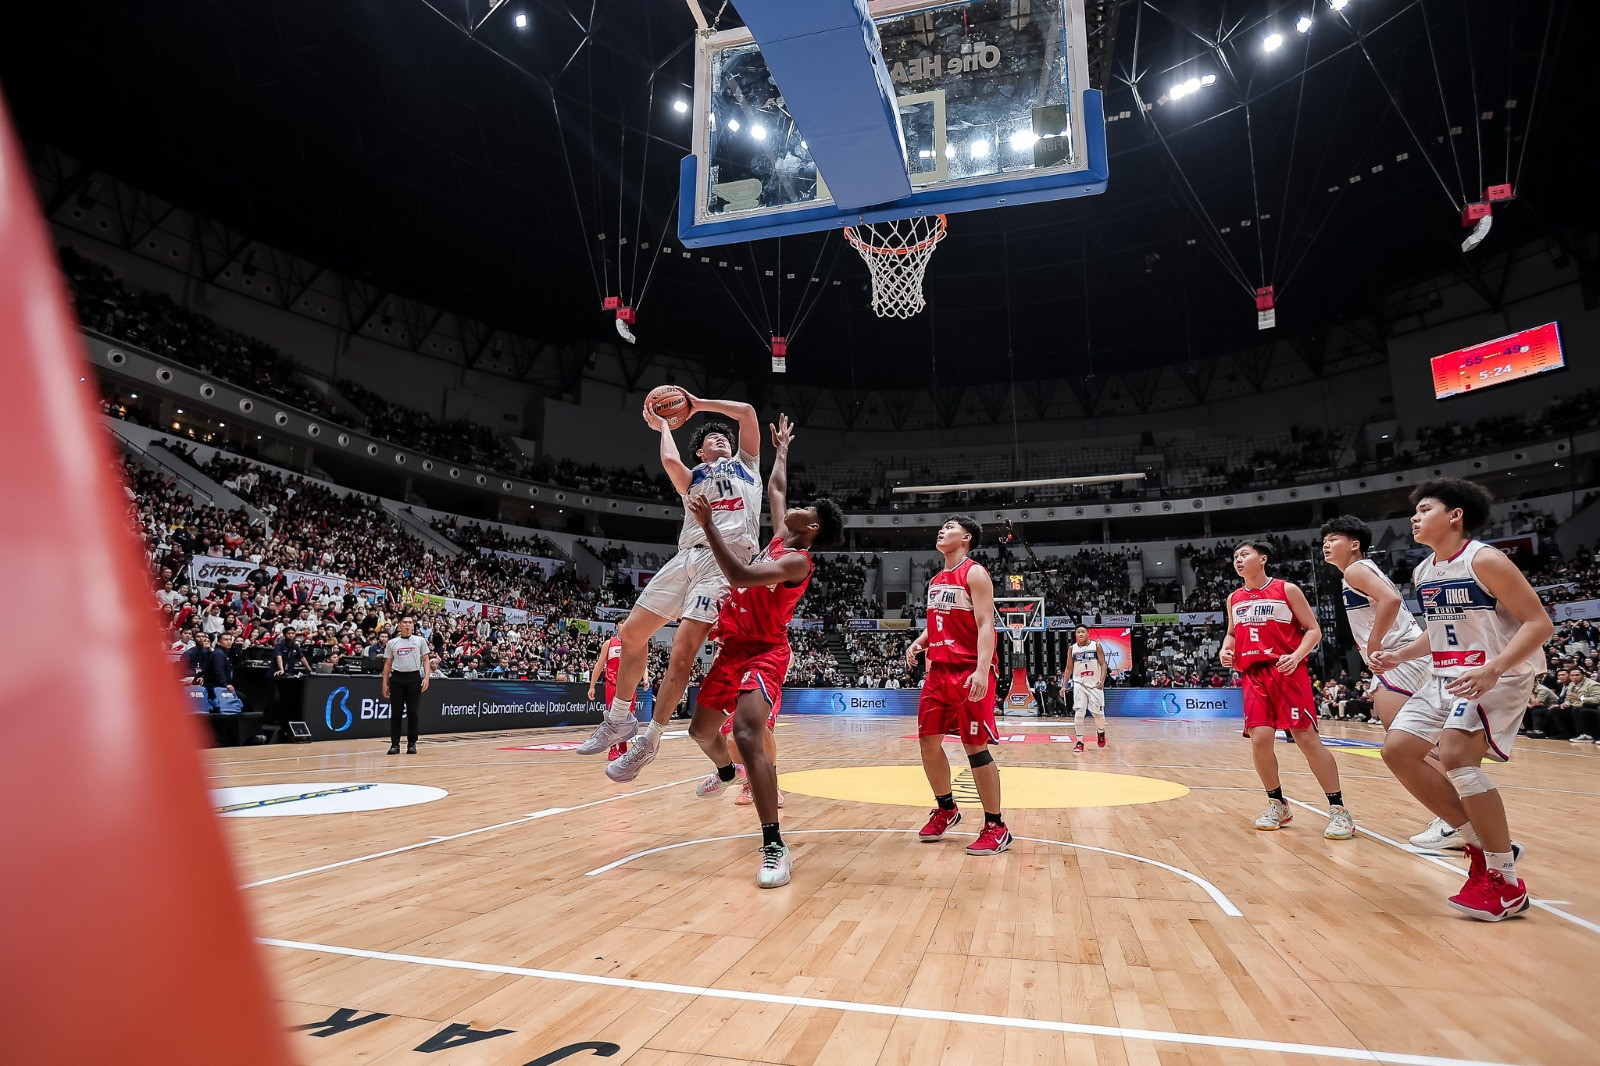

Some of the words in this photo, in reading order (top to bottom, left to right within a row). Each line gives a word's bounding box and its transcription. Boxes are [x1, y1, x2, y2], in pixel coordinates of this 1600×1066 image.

[1465, 355, 1483, 367] 55
[1478, 364, 1513, 380] 5:24
[716, 480, 733, 497] 14
[199, 563, 252, 578] STREET
[1011, 582, 1021, 590] 16
[695, 595, 711, 611] 14
[1445, 588, 1473, 604] FINAL
[1254, 605, 1275, 616] FINAL
[1249, 627, 1260, 642] 5
[1444, 624, 1458, 646] 5
[441, 703, 477, 716] Internet
[482, 702, 524, 715] Submarine
[525, 701, 545, 713] Cable
[549, 702, 566, 713] Data
[566, 702, 586, 712] Center
[851, 697, 886, 708] Biznet
[1185, 699, 1228, 709] Biznet
[1454, 702, 1468, 717] 5
[1291, 707, 1299, 720] 5
[970, 721, 979, 736] 6
